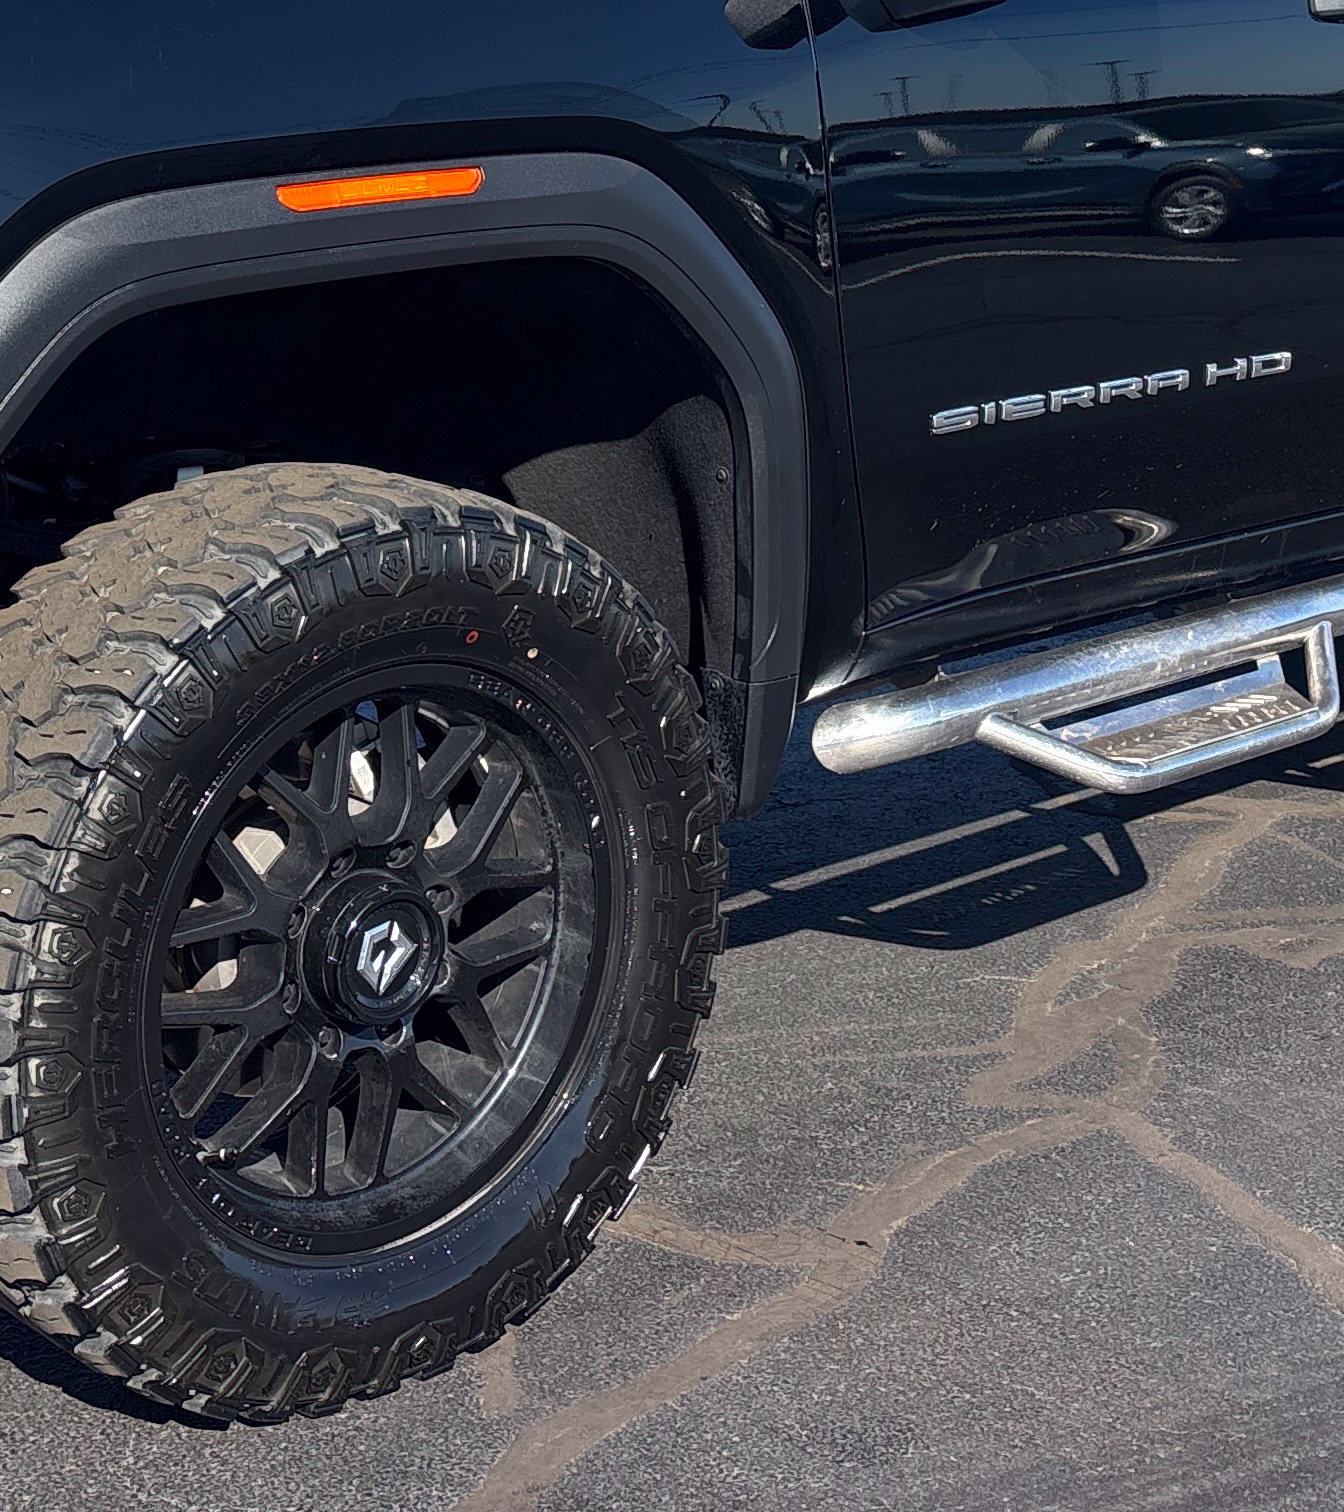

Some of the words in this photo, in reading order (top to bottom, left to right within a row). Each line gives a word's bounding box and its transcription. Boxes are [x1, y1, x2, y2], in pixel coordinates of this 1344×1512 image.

[930, 368, 1191, 435] SIERRA
[1203, 351, 1293, 386] HD
[91, 772, 194, 1161] HERCULES
